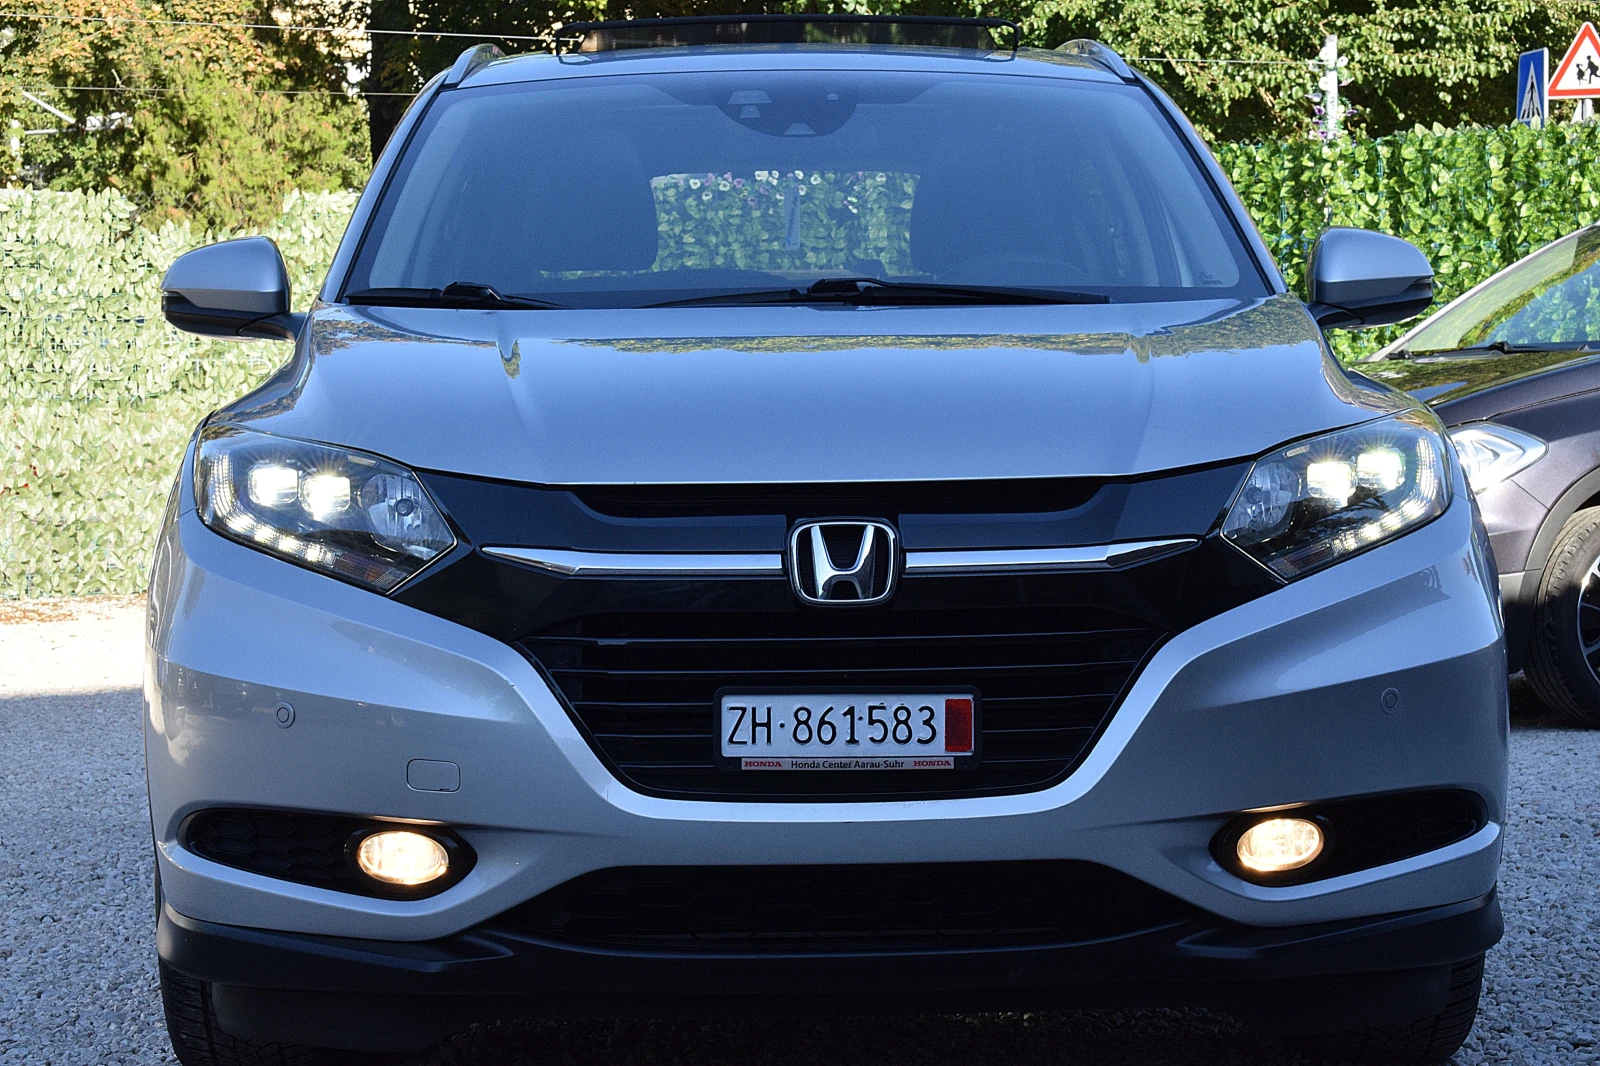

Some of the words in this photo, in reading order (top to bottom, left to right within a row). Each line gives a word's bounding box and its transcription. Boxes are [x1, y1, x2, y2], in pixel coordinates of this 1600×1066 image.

[791, 761, 820, 769] Honda
[822, 760, 852, 769] Center
[854, 760, 905, 769] Aarau-Suhr
